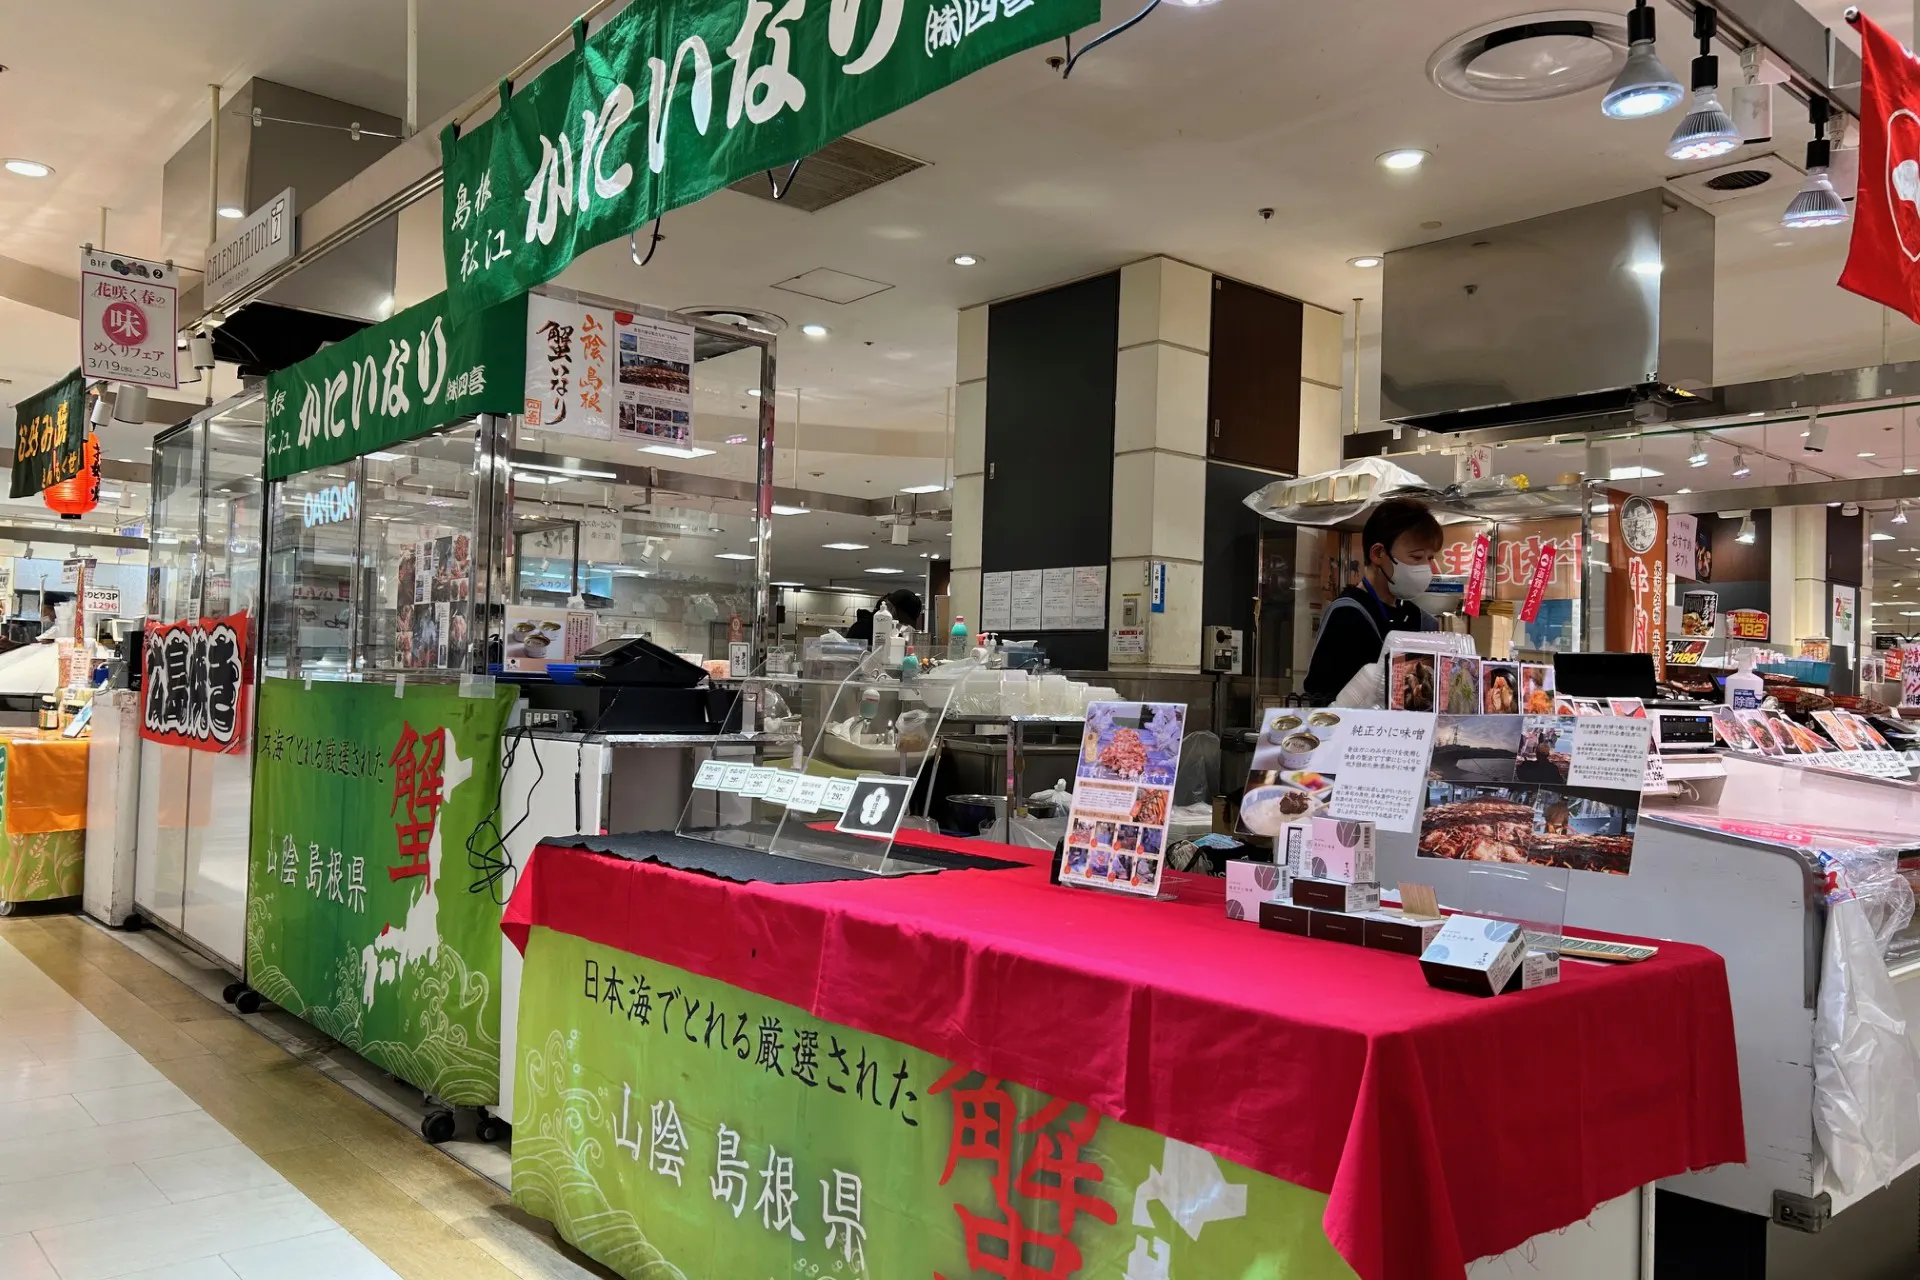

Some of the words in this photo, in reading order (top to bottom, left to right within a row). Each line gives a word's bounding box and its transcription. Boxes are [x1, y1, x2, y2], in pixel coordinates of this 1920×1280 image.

[451, 168, 492, 231] 島根
[90, 259, 107, 268] B1F
[206, 218, 269, 286] CALENDARIUM
[460, 228, 512, 283] 松江
[96, 282, 166, 305] 花咲く春の
[110, 309, 142, 338] 味
[297, 315, 447, 450] かにいなり
[536, 319, 575, 426] 蟹いなり
[1351, 724, 1426, 741] 純正かに味噌
[1735, 696, 1756, 708] 除菌
[831, 793, 842, 801] 297
[267, 828, 300, 889] 山陰
[305, 841, 367, 915] 島根県
[584, 959, 919, 1128] 日本海でとれる厳選された
[611, 1081, 689, 1188] 山陰
[710, 1123, 868, 1266] 島根県
